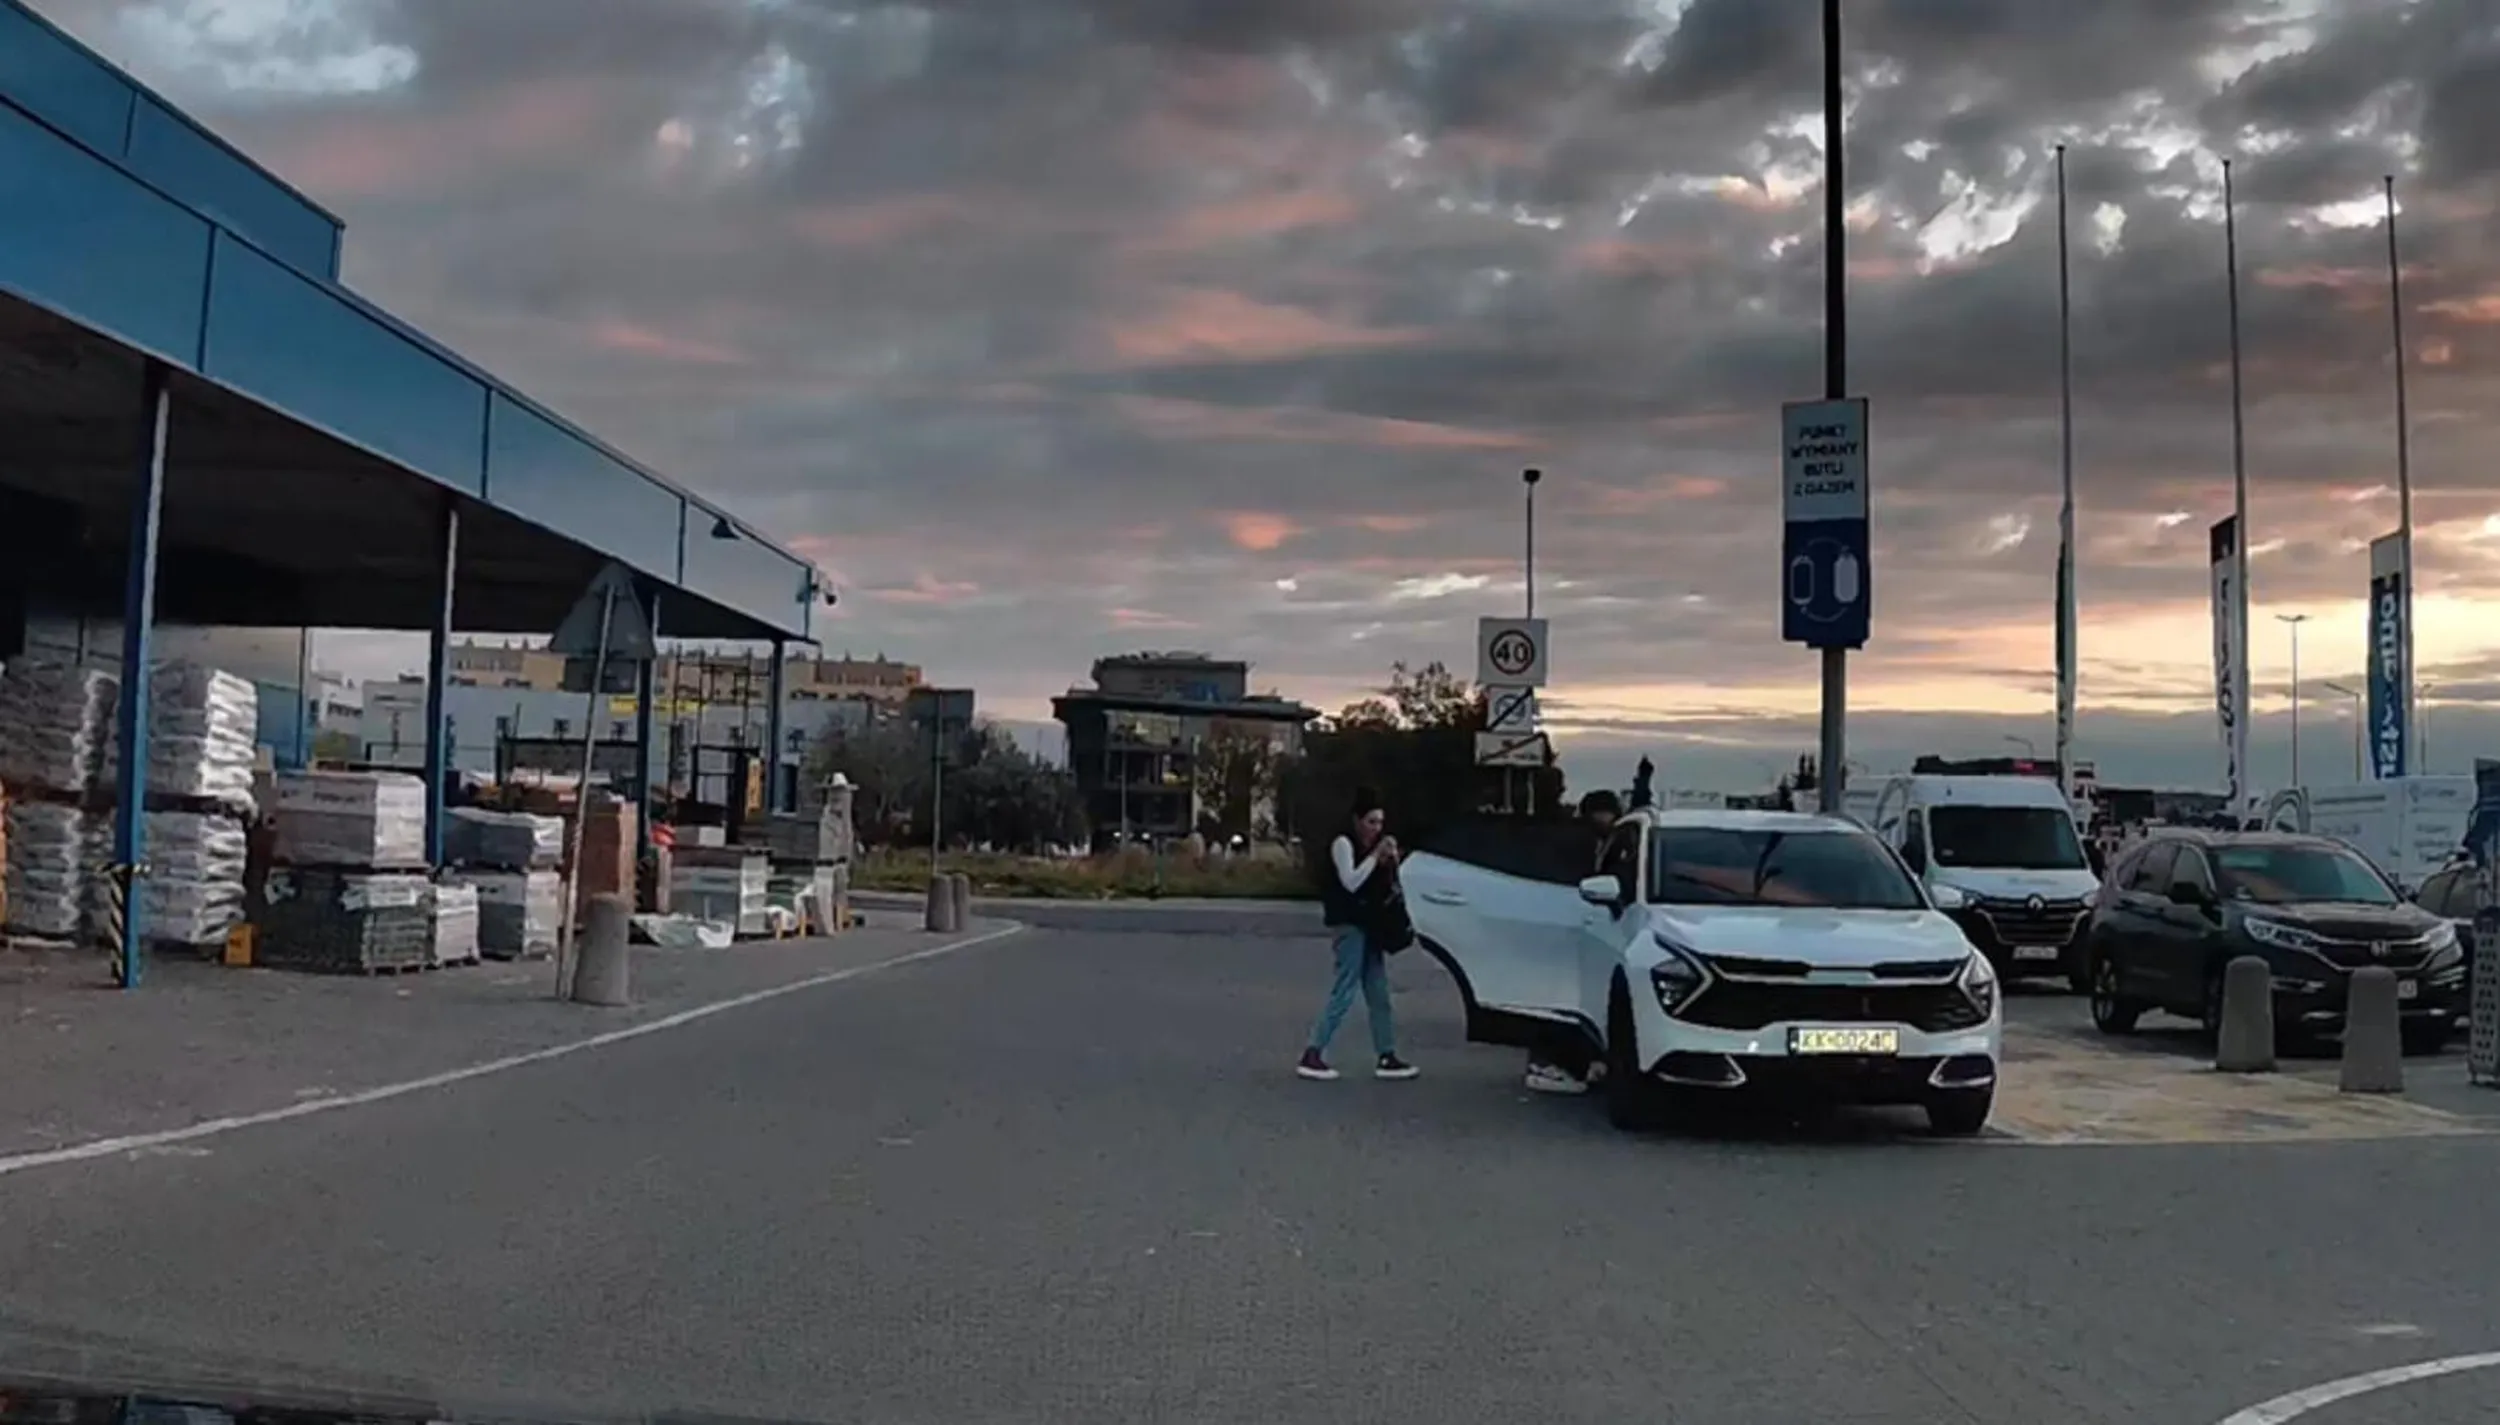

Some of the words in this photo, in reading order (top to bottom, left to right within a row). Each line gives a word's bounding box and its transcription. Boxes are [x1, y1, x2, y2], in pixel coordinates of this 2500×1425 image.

[1800, 425, 1847, 439] PUNKT
[1791, 441, 1858, 458] WYMIANY
[1804, 461, 1844, 476] BUTLI
[1794, 483, 1802, 496] Z
[1805, 480, 1855, 494] GAZEM
[1495, 641, 1529, 665] 40
